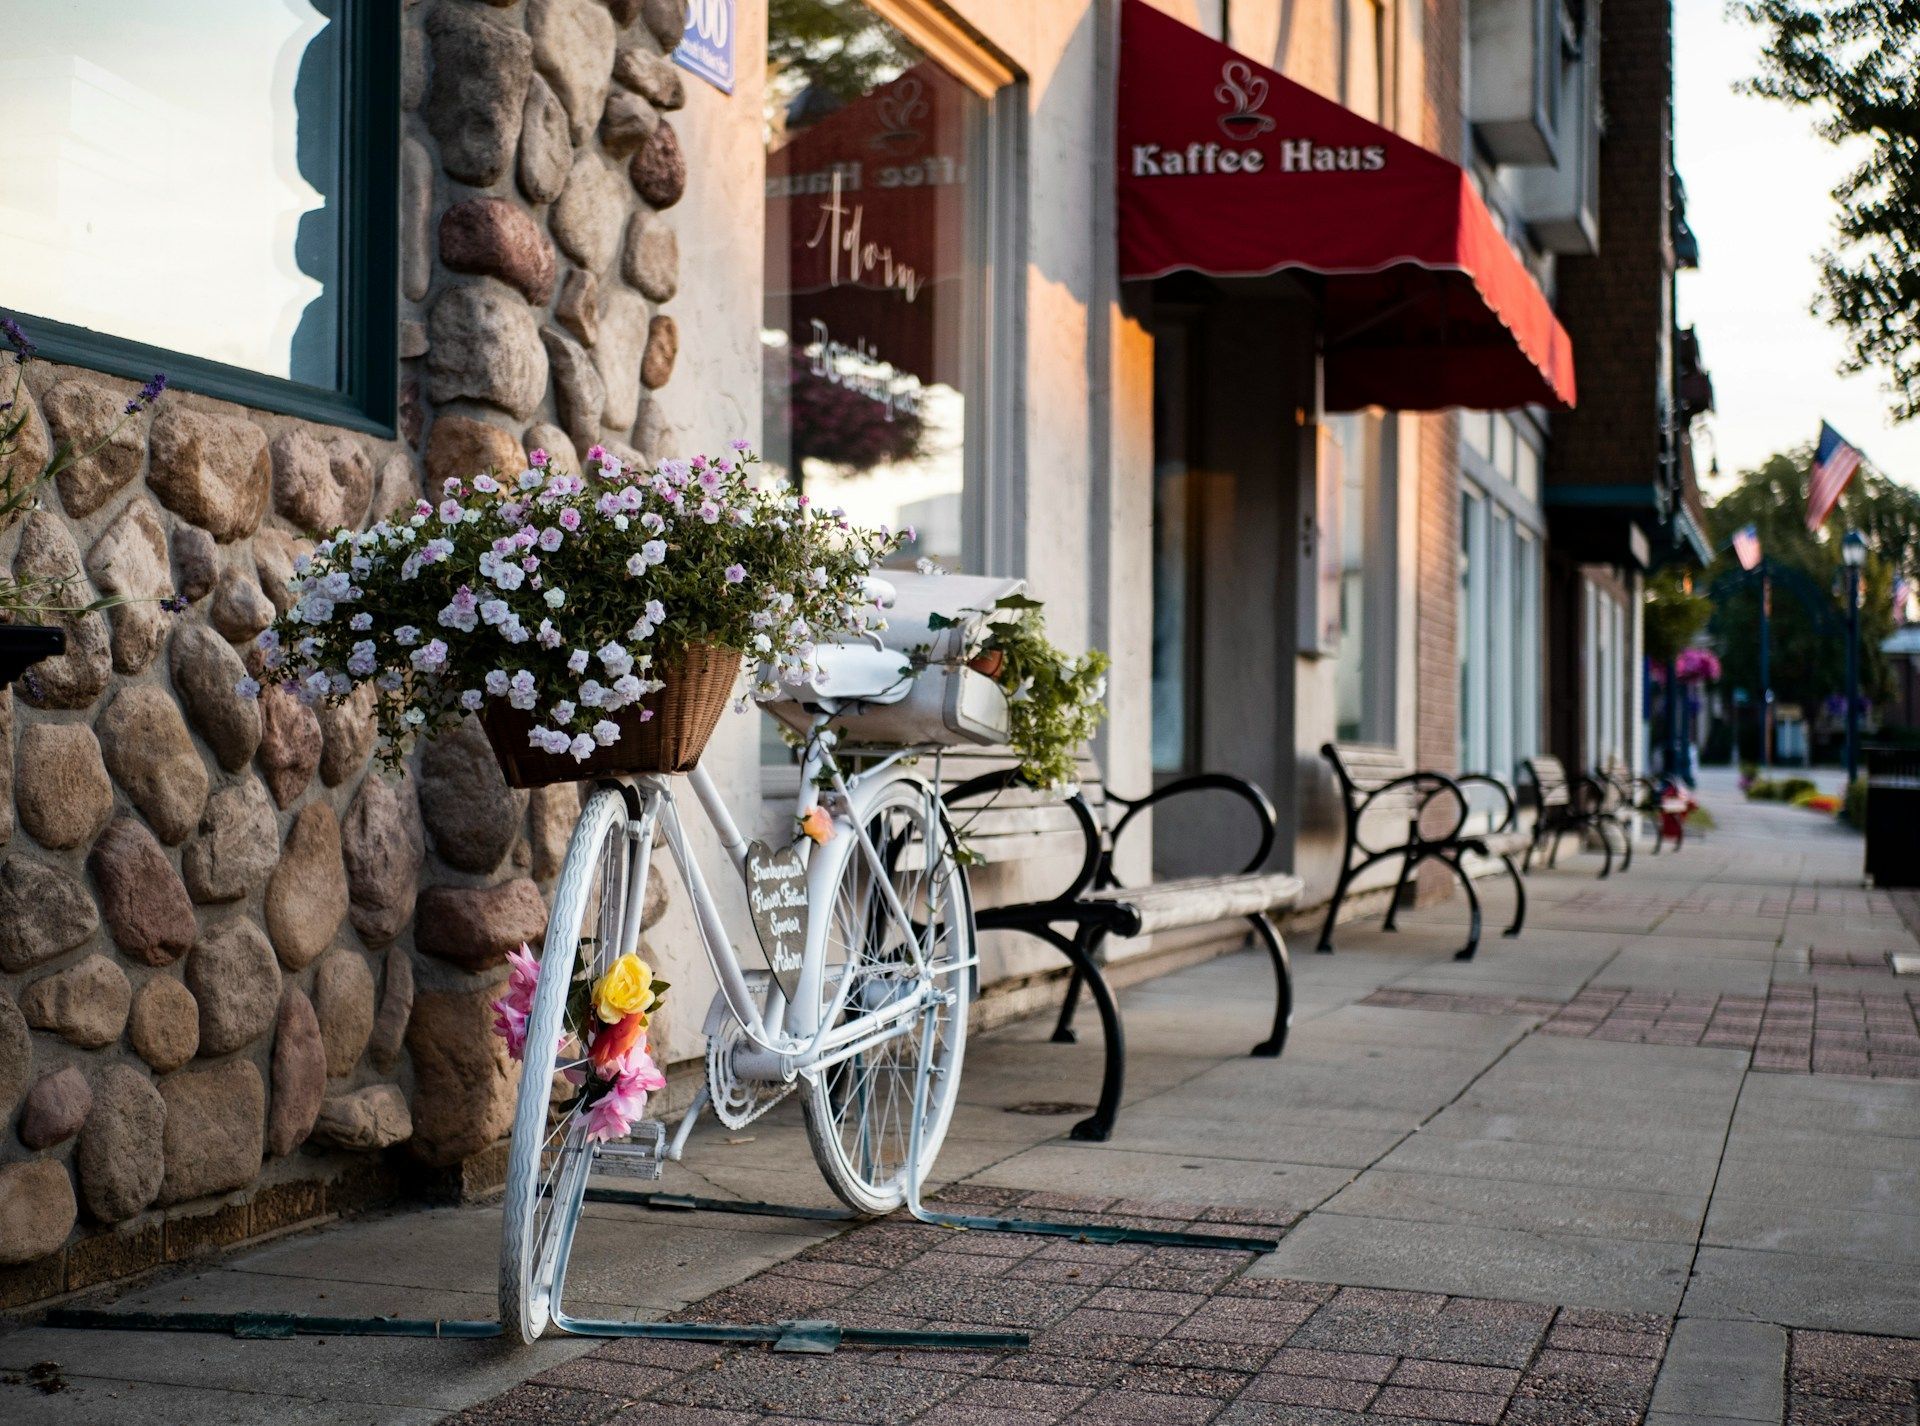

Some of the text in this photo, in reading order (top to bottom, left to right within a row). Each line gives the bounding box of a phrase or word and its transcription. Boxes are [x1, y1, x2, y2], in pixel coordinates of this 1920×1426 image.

[1132, 139, 1386, 176] Kaffee Haus
[807, 171, 924, 303] Adorn
